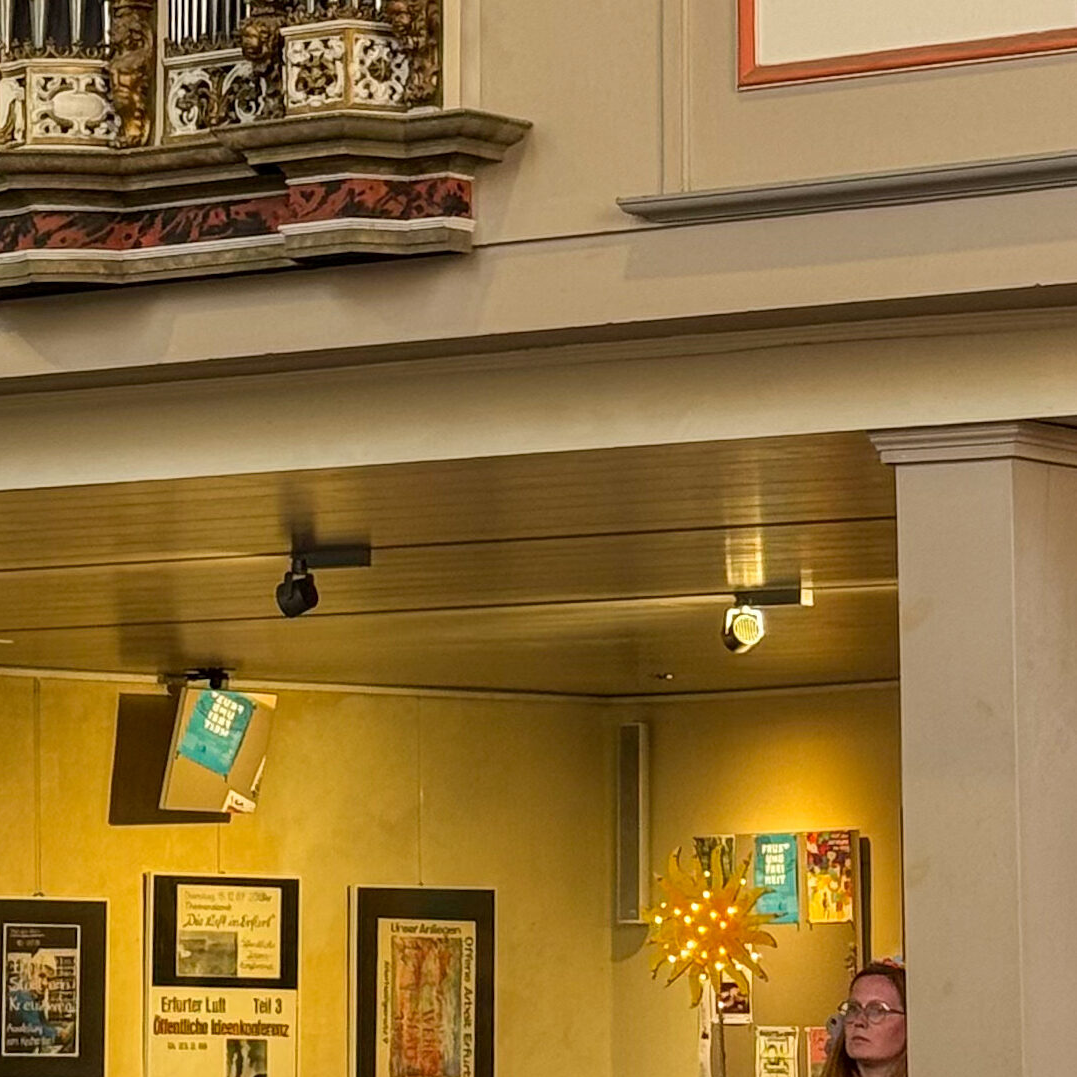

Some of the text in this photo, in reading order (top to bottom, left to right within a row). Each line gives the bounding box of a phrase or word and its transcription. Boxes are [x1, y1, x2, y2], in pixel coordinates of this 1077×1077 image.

[161, 996, 282, 1014] Erfurter Luft Teil 3
[153, 1014, 209, 1035] Öffentliche
